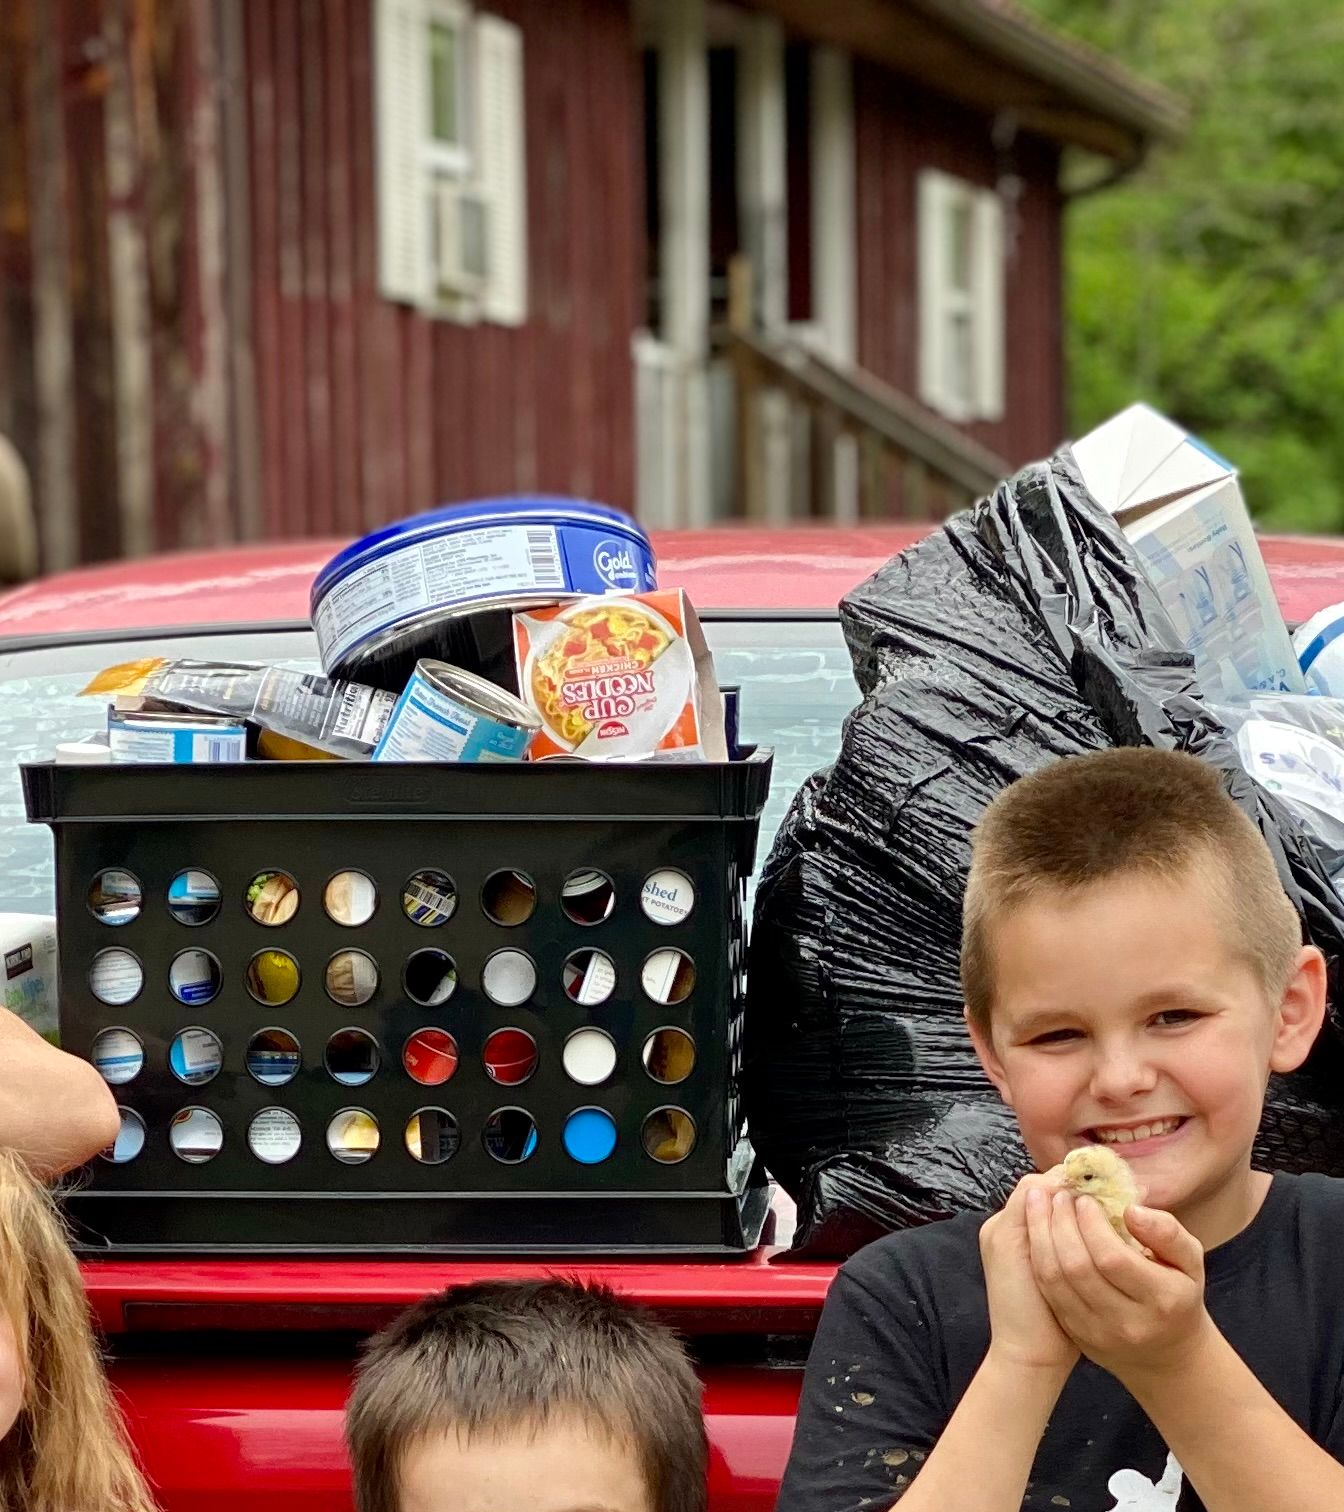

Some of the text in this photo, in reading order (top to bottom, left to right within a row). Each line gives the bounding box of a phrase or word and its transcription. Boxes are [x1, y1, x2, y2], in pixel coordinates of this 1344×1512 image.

[598, 550, 633, 581] Gold
[562, 671, 654, 704] NOODLES
[583, 695, 635, 721] CUP
